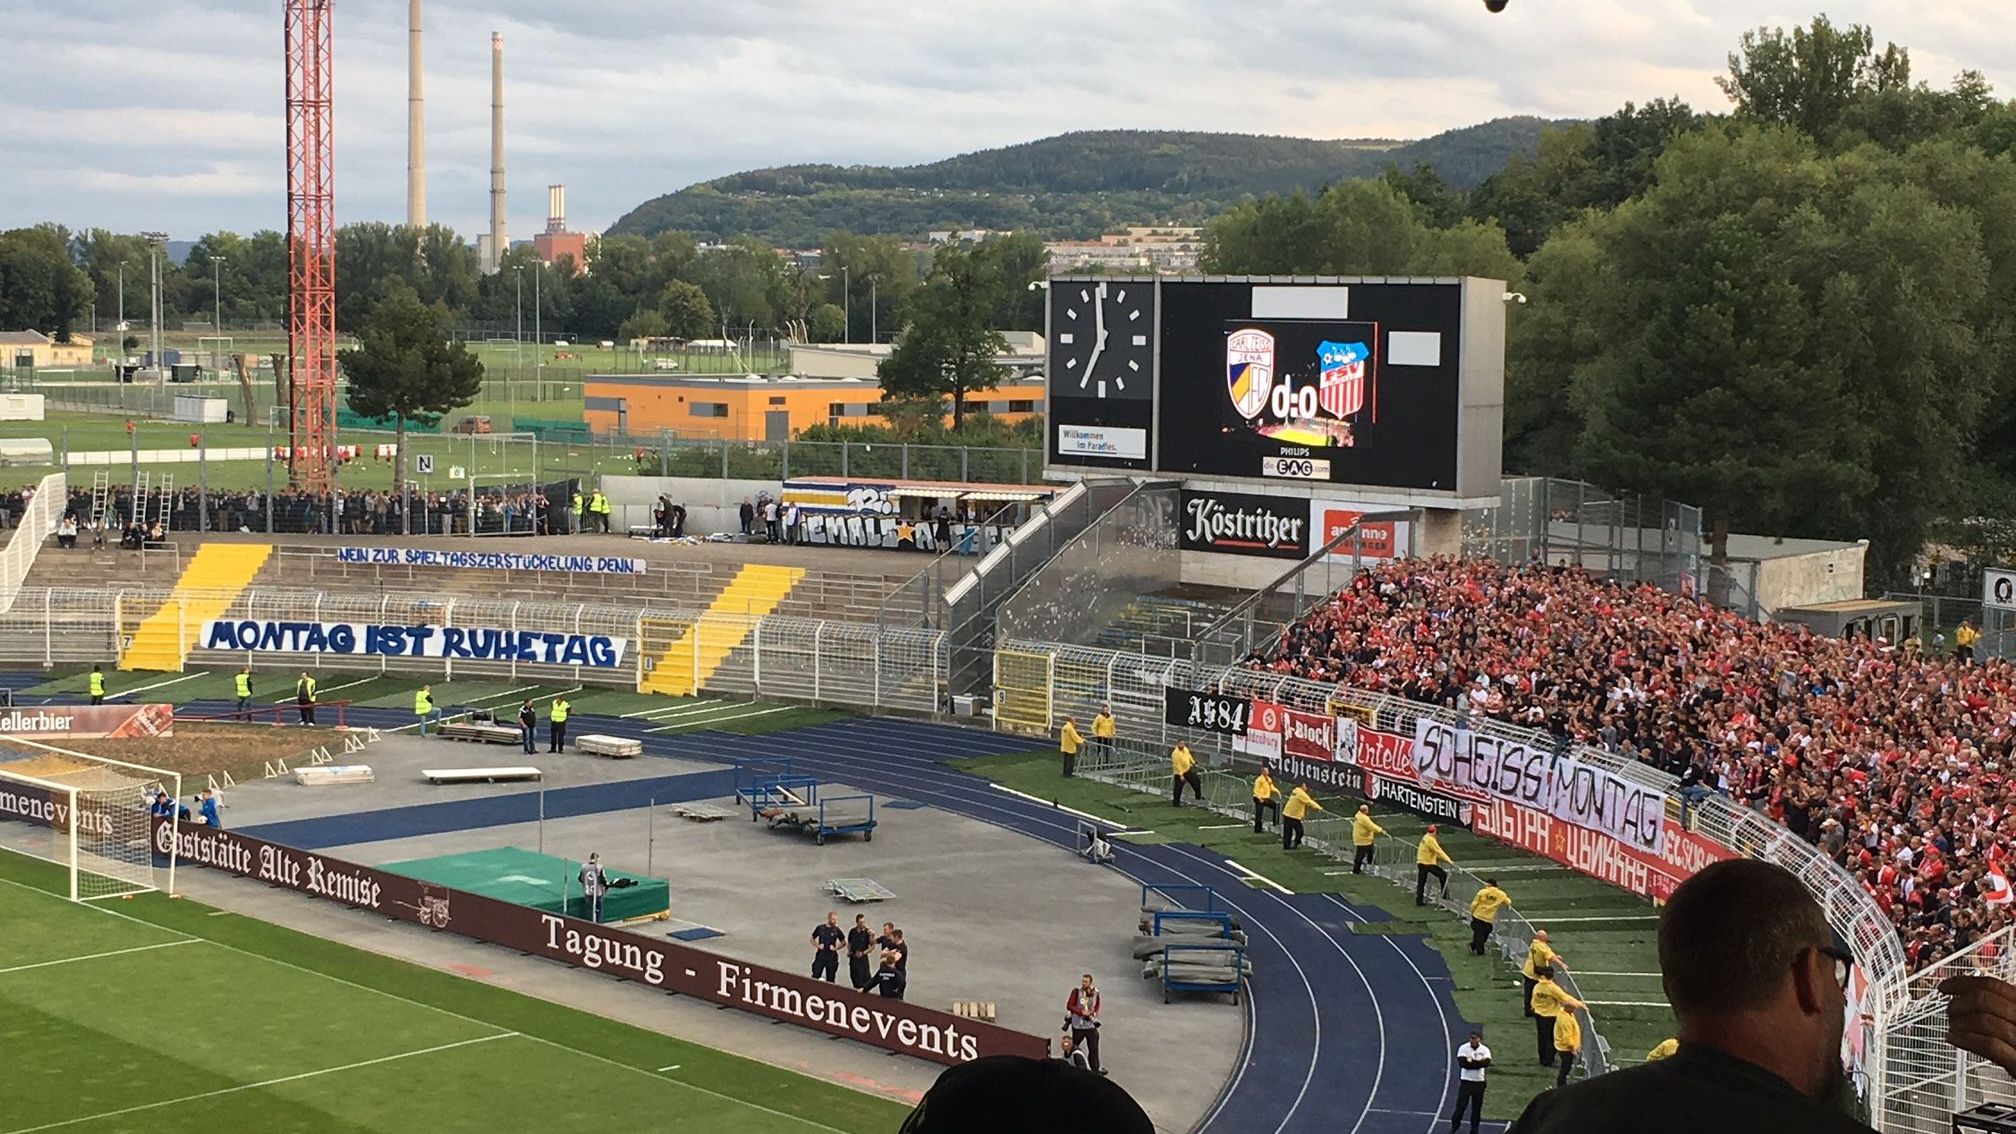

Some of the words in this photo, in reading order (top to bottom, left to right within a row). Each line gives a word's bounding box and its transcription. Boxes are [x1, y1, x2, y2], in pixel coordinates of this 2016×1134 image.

[1238, 353, 1263, 363] JENA
[1325, 361, 1361, 382] FSV
[1063, 430, 1104, 441] Willkommen
[1280, 447, 1310, 457] PHILIPS
[419, 456, 431, 471] N
[338, 548, 368, 562] NEIN
[372, 548, 400, 564] ZUR
[207, 620, 356, 653] MONTAG
[364, 622, 434, 657] IST
[442, 628, 618, 668] RUHETAG
[0, 710, 74, 731] ellerbier
[1418, 724, 1545, 800] SCHEISS
[1555, 762, 1661, 846] MONTAG
[1381, 780, 1457, 819] HARTENSTEIN
[259, 844, 300, 887] Alte
[306, 856, 382, 908] Remise
[541, 914, 664, 984] Tagung
[685, 968, 696, 977] -
[716, 961, 978, 1062] Firmenevents
